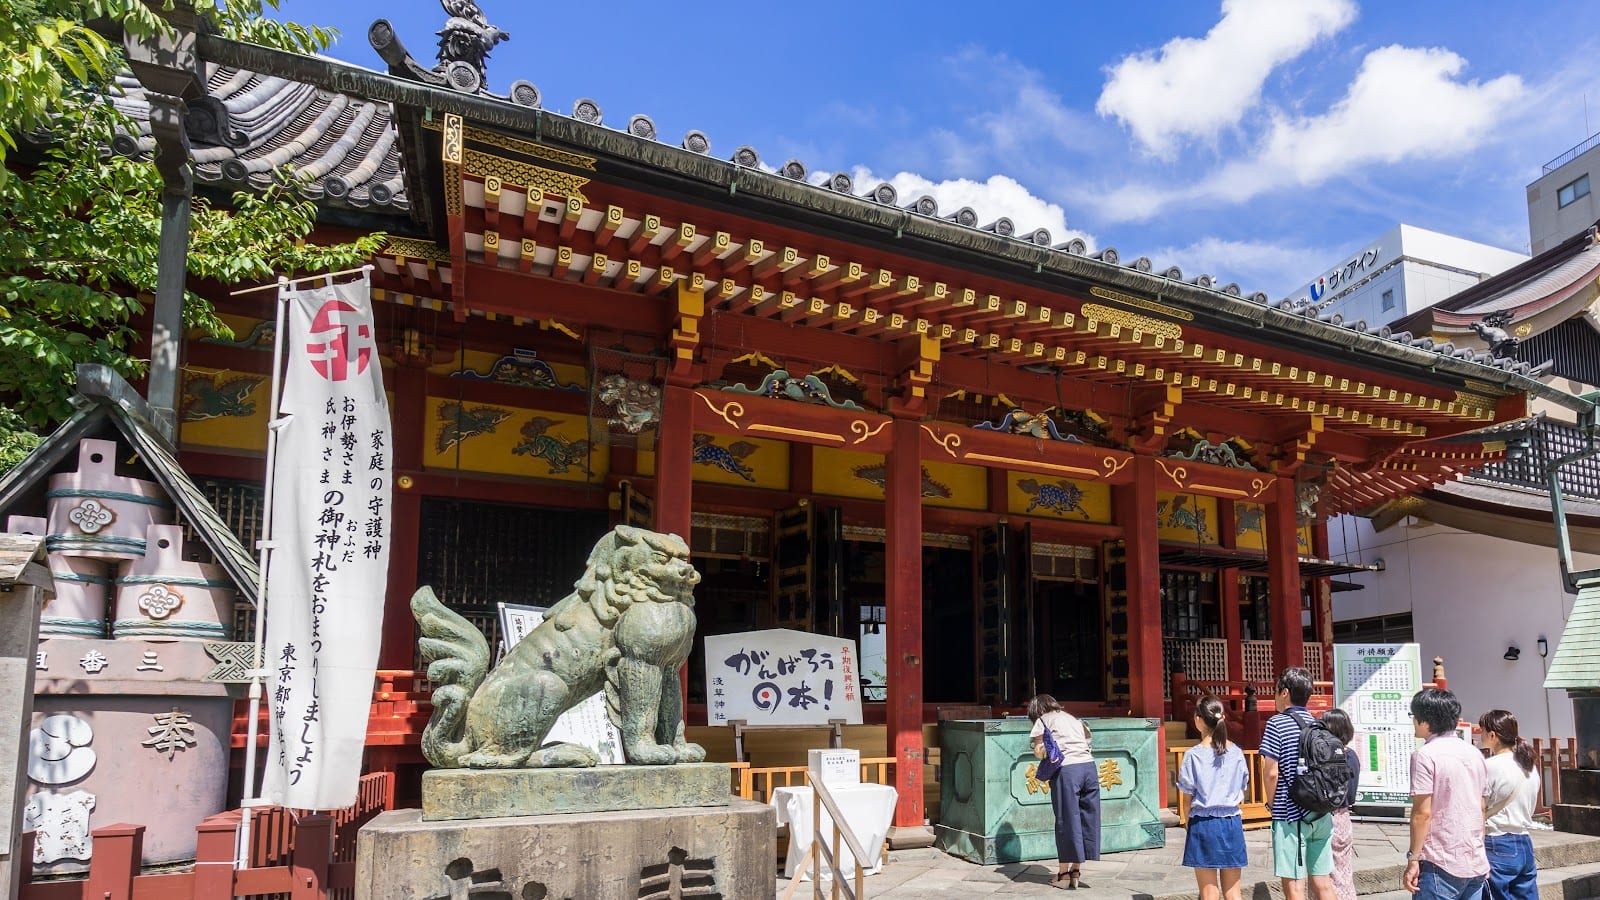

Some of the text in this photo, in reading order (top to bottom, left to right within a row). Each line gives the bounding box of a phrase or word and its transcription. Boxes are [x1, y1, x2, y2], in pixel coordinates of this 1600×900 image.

[1328, 247, 1381, 290] ヴィアイン
[319, 396, 337, 484] 氏神さま
[339, 396, 357, 485] お伊勢さま
[363, 429, 385, 560] 家庭の守護神
[342, 519, 358, 563] おふだ
[724, 647, 834, 680] がんばろう
[141, 707, 197, 761] 奉
